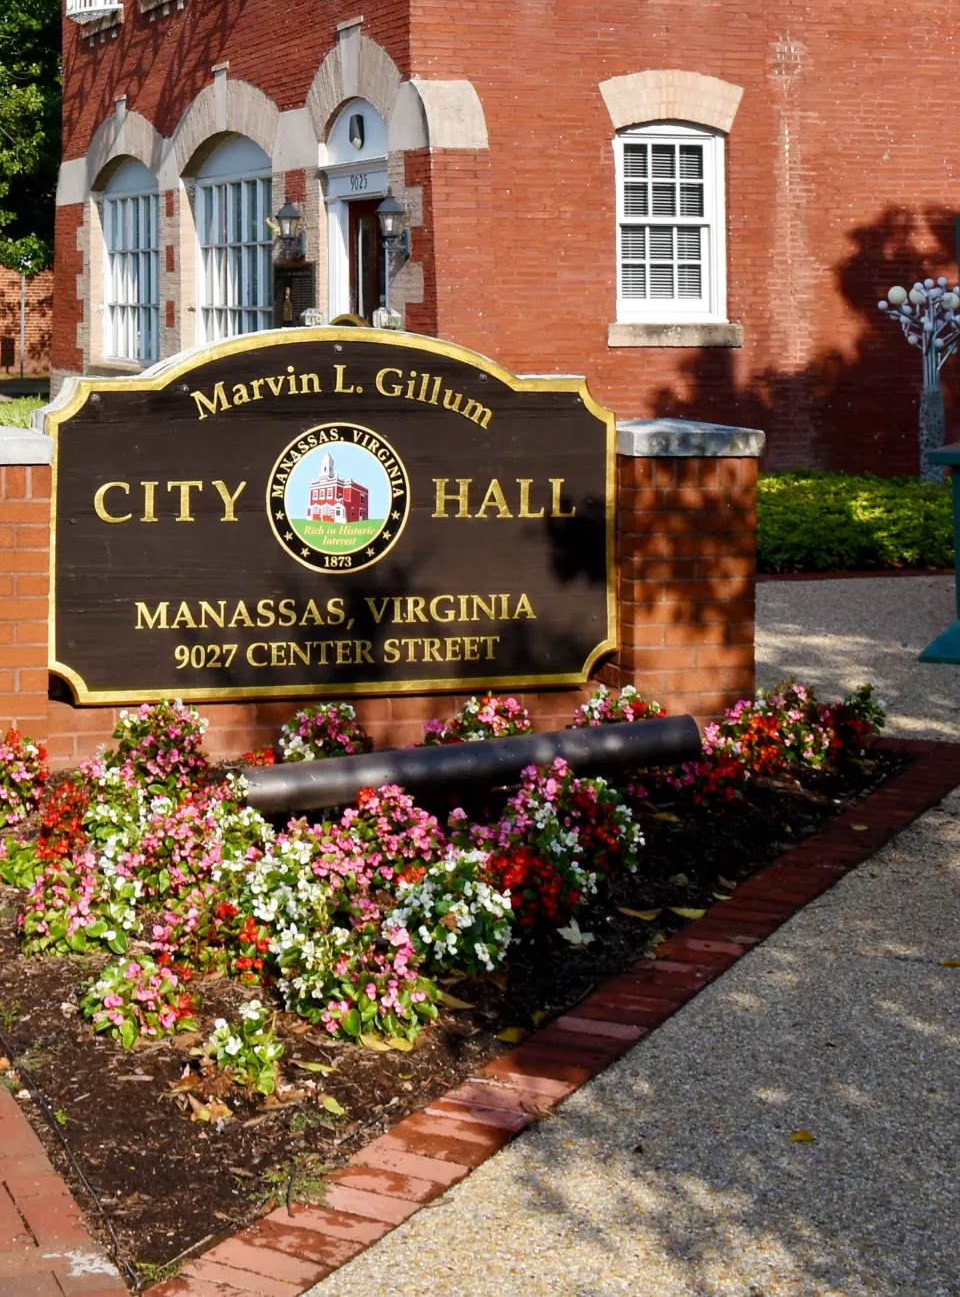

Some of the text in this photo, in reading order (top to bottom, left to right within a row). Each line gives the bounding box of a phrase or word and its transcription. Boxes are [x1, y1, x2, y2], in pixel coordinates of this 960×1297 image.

[350, 173, 368, 191] 9025
[190, 364, 493, 430] Marvin L. Gillum
[271, 428, 405, 499] MANASSAS, VIRGINIA
[93, 479, 247, 523] CITY
[431, 477, 577, 520] HALL
[303, 524, 376, 535] Rich in Historic
[322, 535, 357, 546] Interest
[323, 556, 353, 568] 1873
[134, 593, 537, 630] MANASSAS, VIRGINIA
[173, 635, 501, 670] 9027 CENTER STREET
